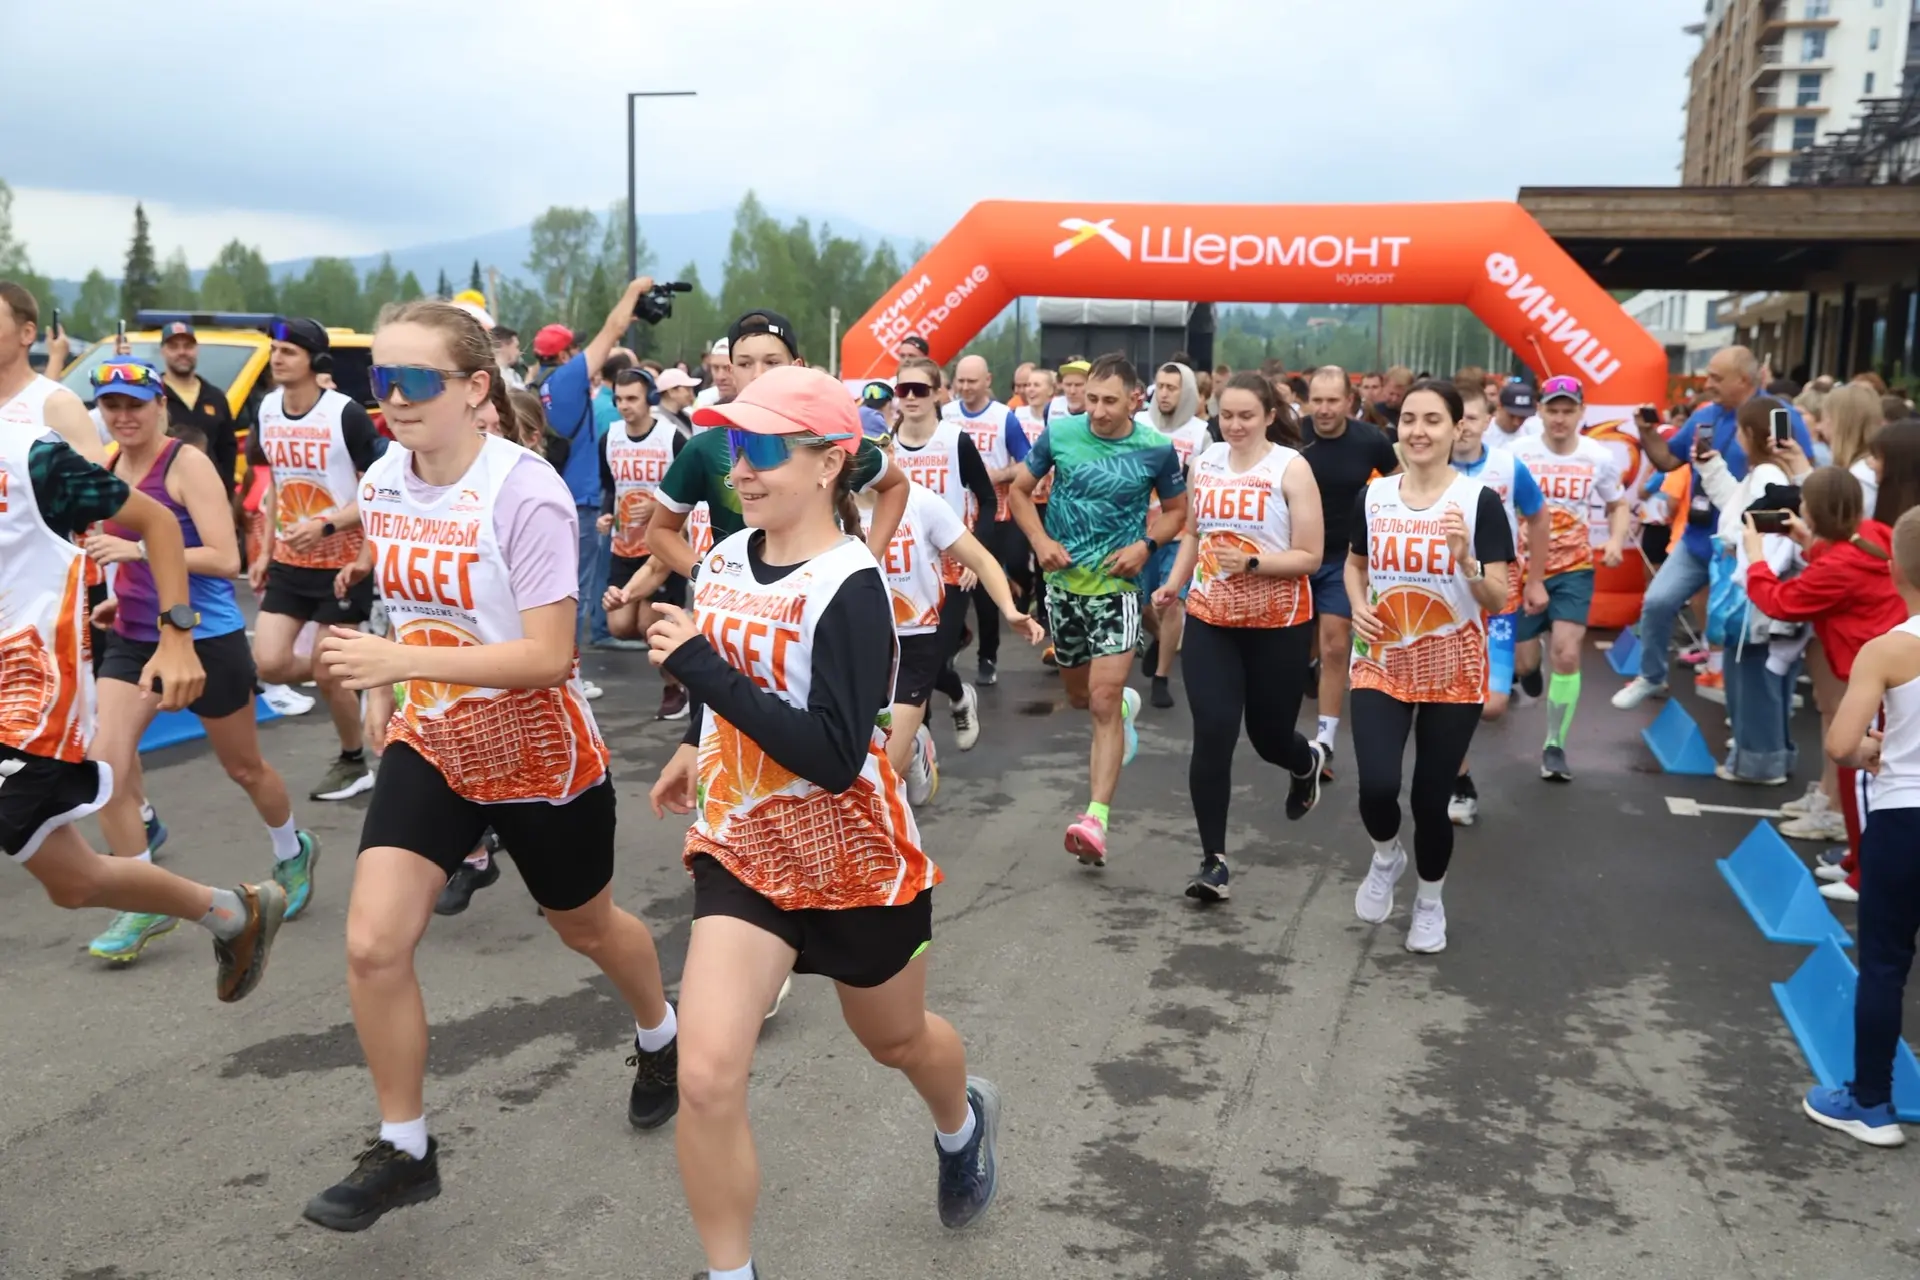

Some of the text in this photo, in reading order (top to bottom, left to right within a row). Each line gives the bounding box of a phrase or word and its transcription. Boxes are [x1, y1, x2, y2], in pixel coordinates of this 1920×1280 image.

[1140, 225, 1411, 271] Шермонт
[1336, 272, 1396, 286] курорт
[1485, 252, 1621, 385] ФИНИШ
[612, 459, 668, 482] ЗАБЕГ
[1539, 476, 1592, 500] АБЕГ
[1194, 486, 1272, 522] ЗАБЕГ
